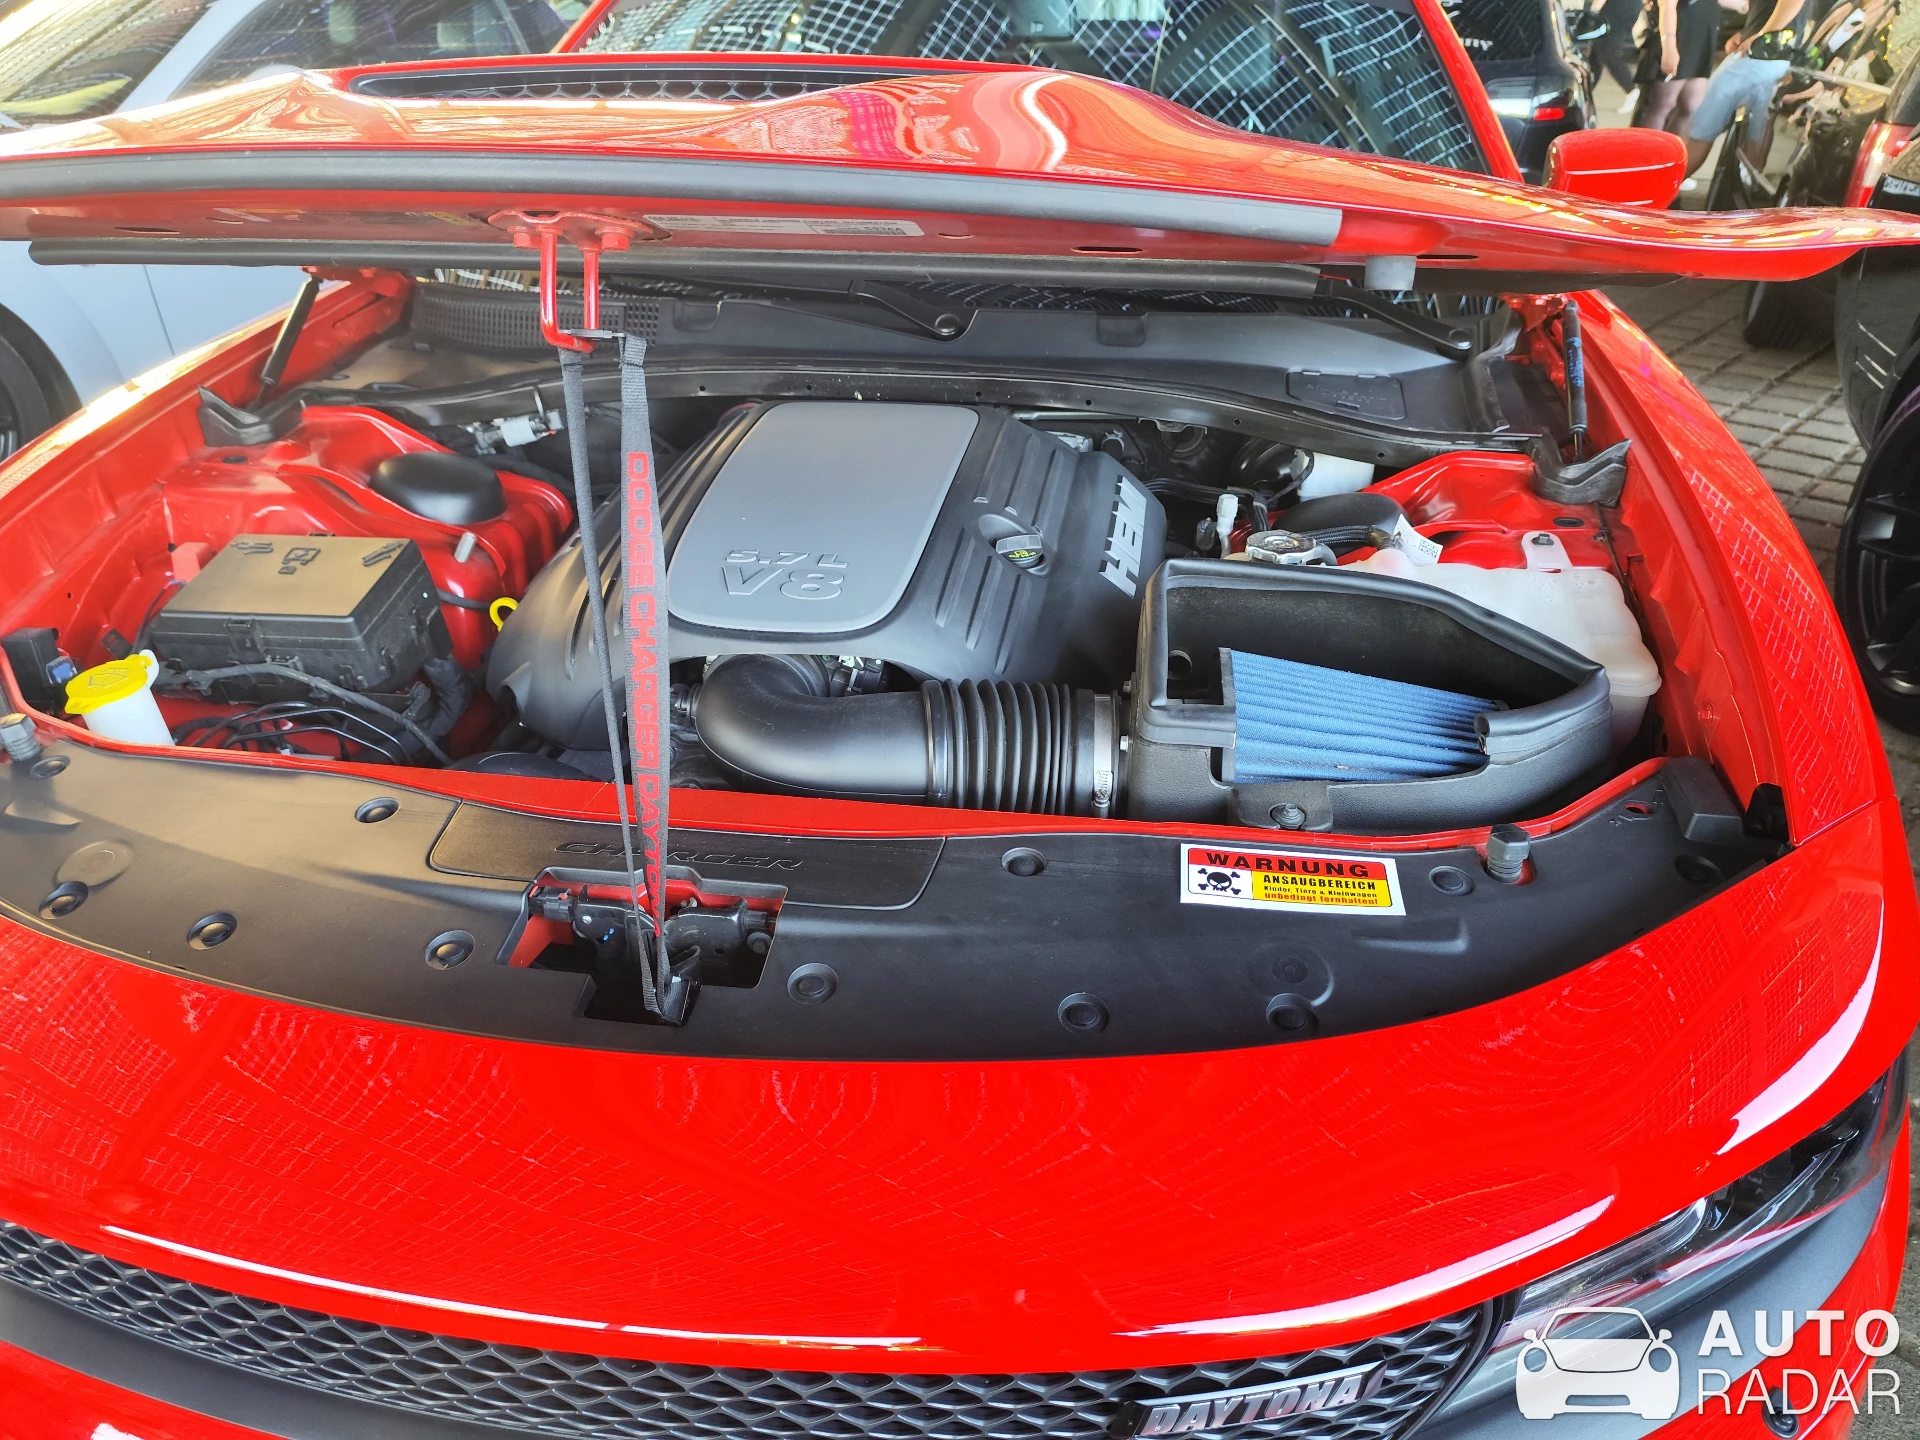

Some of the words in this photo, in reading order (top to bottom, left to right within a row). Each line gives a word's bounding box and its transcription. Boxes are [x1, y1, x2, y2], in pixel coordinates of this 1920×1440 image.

[627, 452, 654, 588] DODGE
[1099, 475, 1147, 600] HEMI
[726, 549, 810, 565] 5.7
[817, 553, 849, 569] L
[722, 566, 845, 601] V8
[630, 593, 660, 769] CHARGER
[555, 842, 803, 870] CHRGER
[1206, 852, 1369, 878] WARNUNG
[1263, 875, 1376, 890] ANSAUGBEREICH
[1328, 890, 1377, 898] Kleinwagen
[1265, 892, 1317, 903] unbedingt
[1320, 896, 1378, 905] fernhalten!
[1143, 1374, 1363, 1435] DAYTONA
